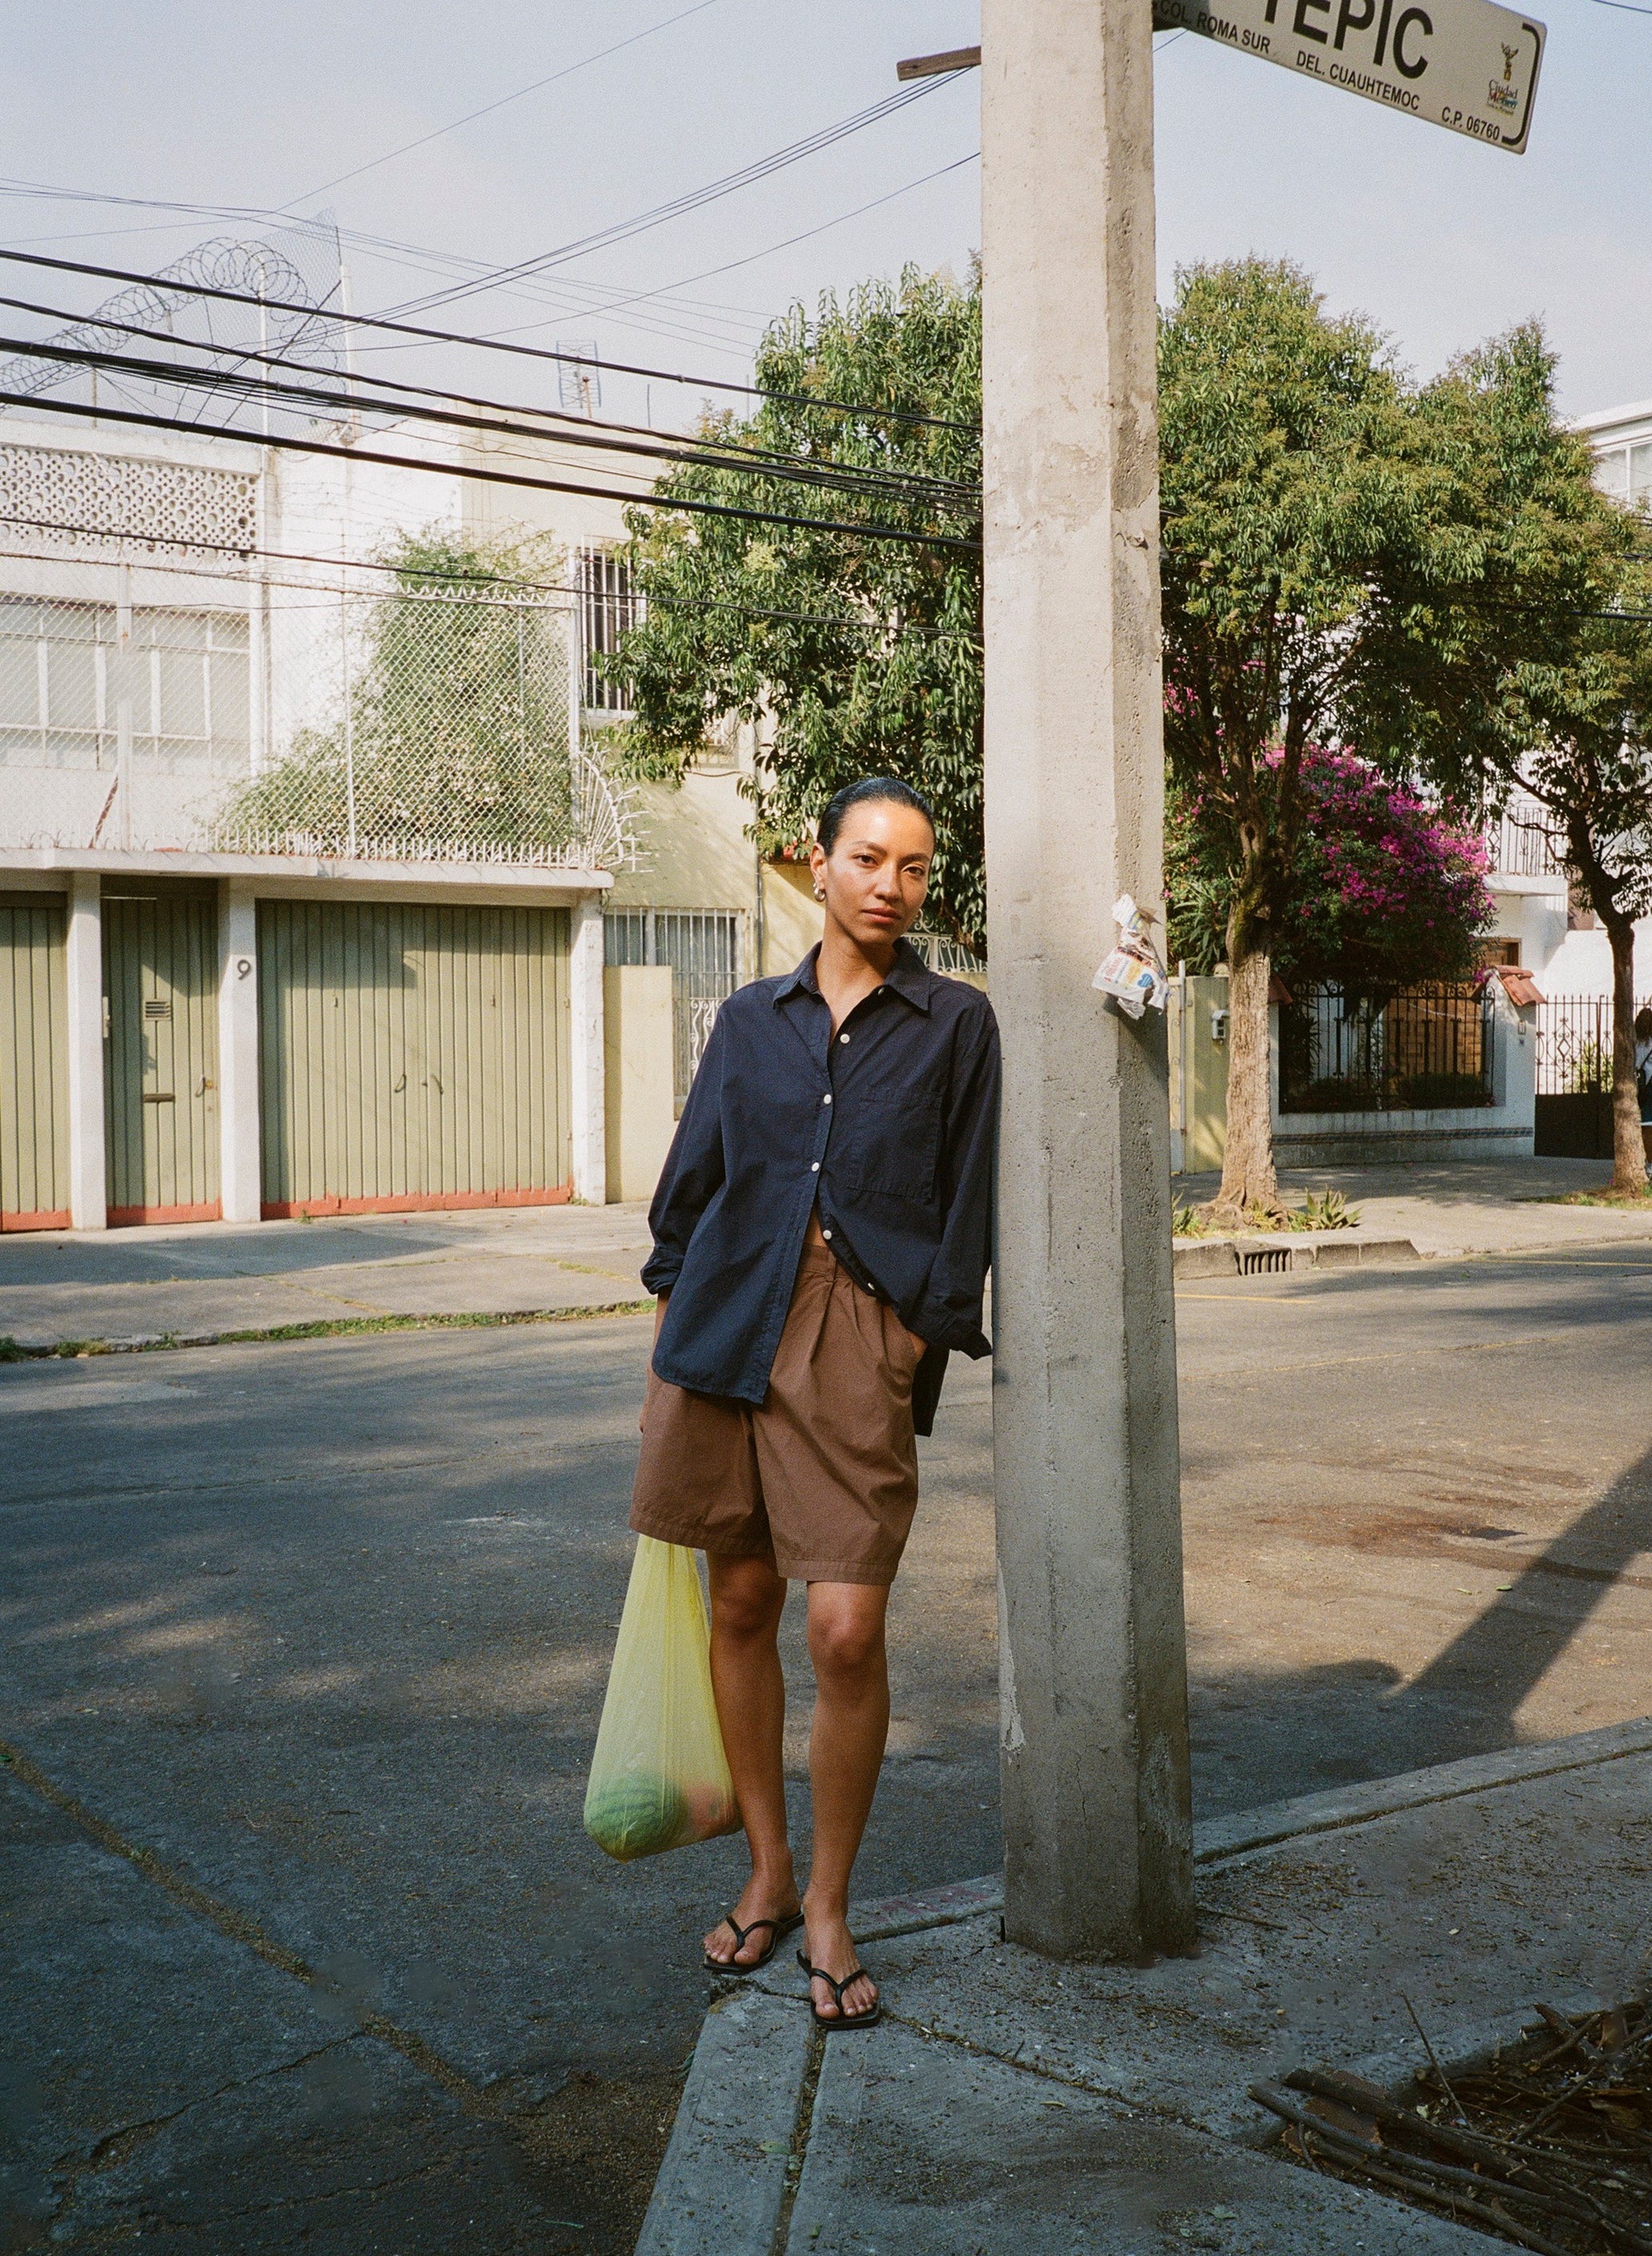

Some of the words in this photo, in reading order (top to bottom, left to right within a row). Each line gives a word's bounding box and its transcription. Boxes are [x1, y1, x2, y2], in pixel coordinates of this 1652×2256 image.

[1197, 11, 1238, 42] ROMA
[1242, 29, 1271, 54] SUR
[1296, 50, 1325, 75] DEL.
[1329, 63, 1420, 110] CUAUHTEMOC
[1442, 106, 1463, 128] C.P.
[1467, 115, 1500, 141] 06760
[237, 959, 251, 981] 9
